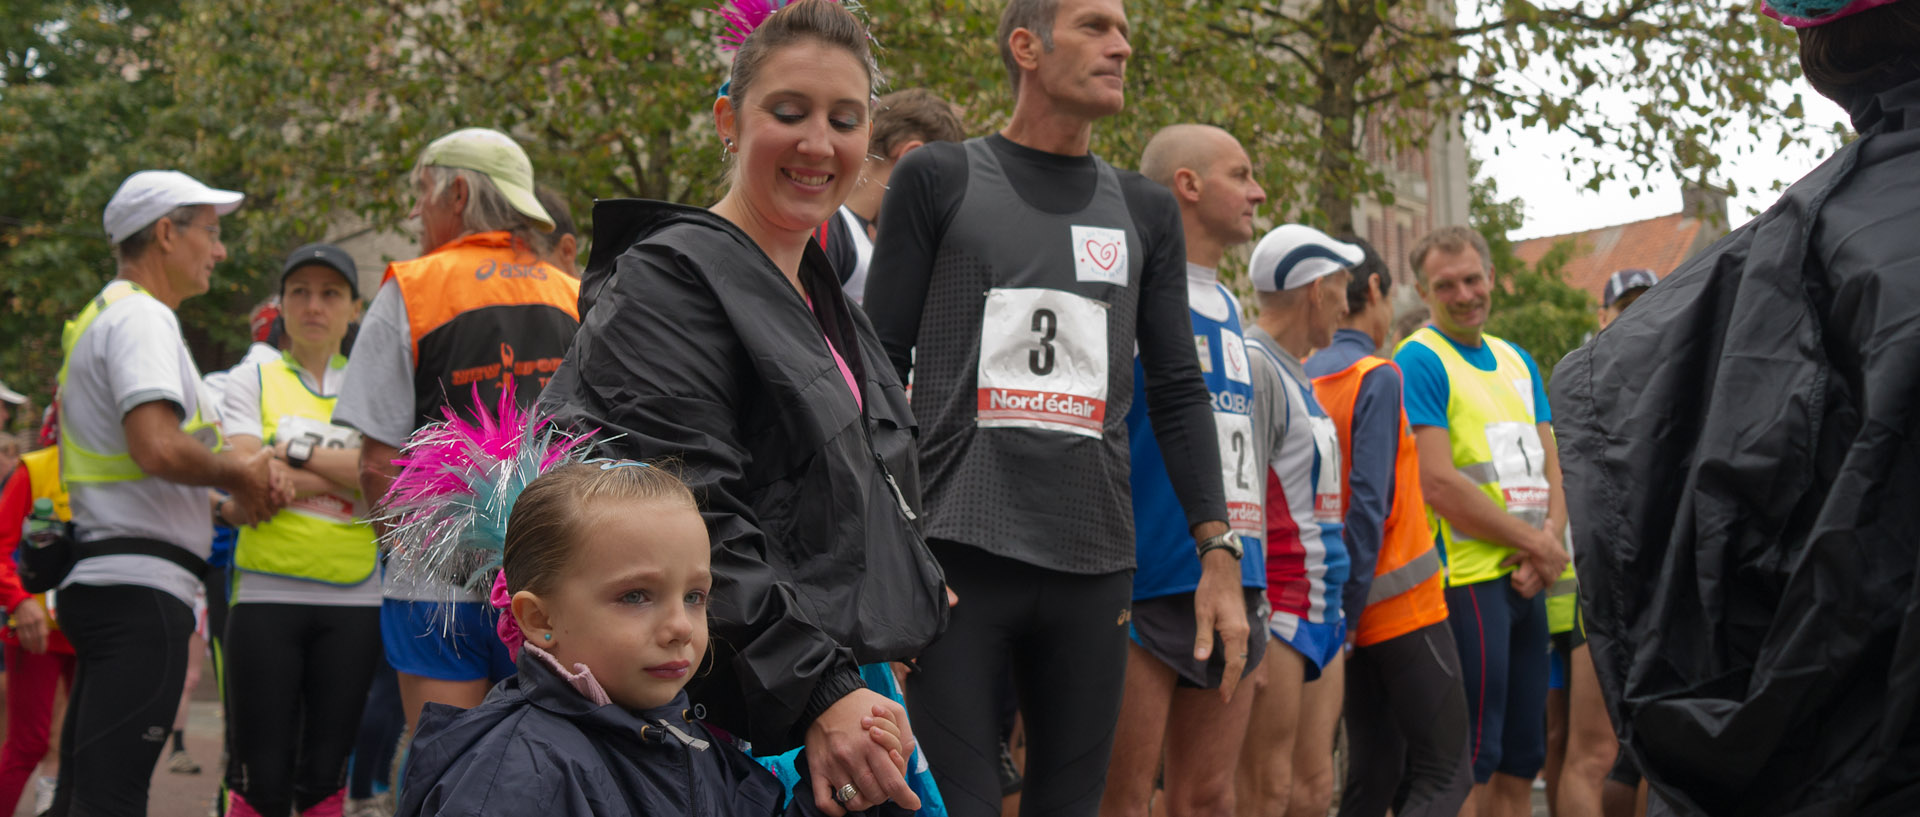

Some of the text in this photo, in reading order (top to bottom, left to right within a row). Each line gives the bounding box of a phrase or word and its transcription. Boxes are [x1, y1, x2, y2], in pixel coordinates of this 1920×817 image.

[499, 263, 547, 280] asics
[1029, 308, 1057, 376] 3
[990, 390, 1096, 418] Nord éclair
[1231, 431, 1249, 489] 2
[1517, 436, 1531, 477] 1
